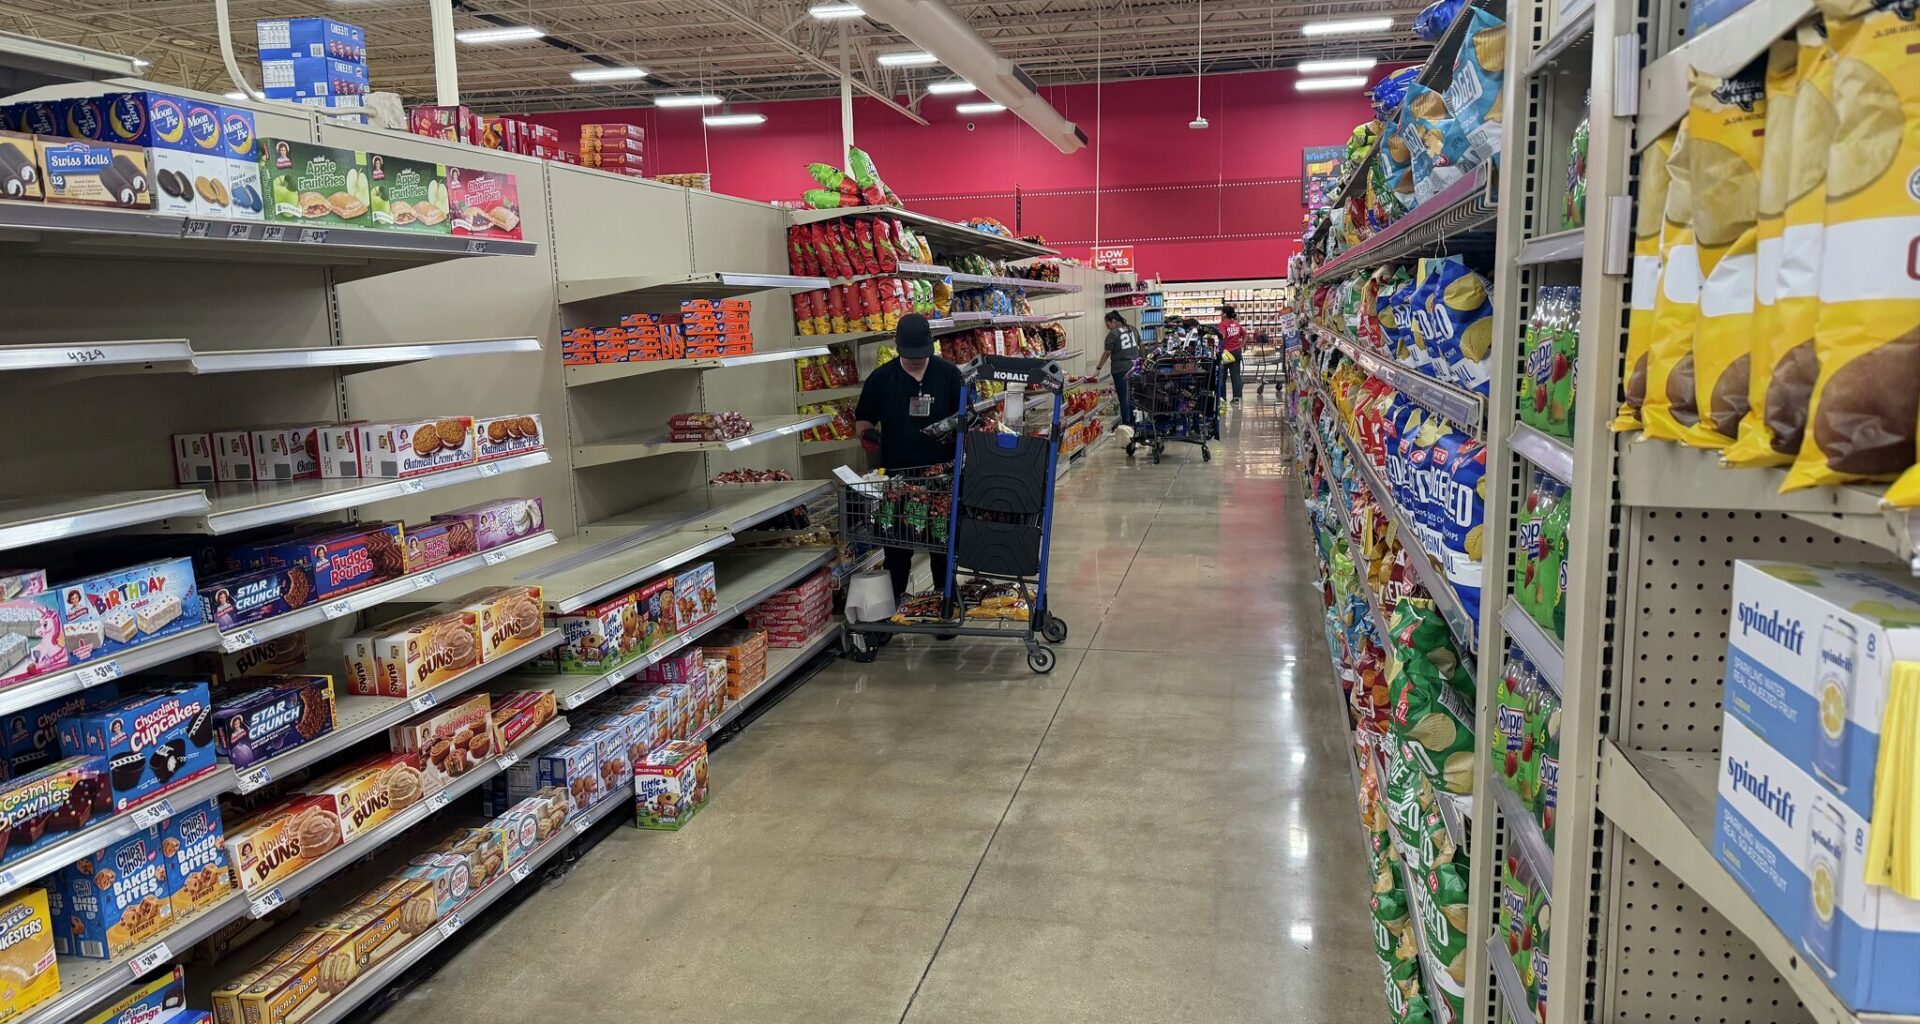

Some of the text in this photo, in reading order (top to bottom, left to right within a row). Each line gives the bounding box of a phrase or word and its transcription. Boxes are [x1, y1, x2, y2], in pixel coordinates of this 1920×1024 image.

[150, 107, 173, 121] Moon
[166, 115, 179, 128] Pie
[187, 114, 209, 128] Moon
[202, 121, 214, 134] Pie
[223, 121, 243, 134] Moon
[237, 129, 248, 141] Pie
[51, 155, 109, 167] Swiss Rolls
[306, 161, 336, 176] Apple
[52, 176, 64, 185] 12
[298, 175, 345, 190] Fruit Pies
[396, 172, 421, 189] Apple
[468, 179, 496, 193] Cherry
[389, 185, 428, 200] Fruit Pies
[465, 190, 501, 206] Fruit Pies
[1100, 250, 1123, 258] LOW
[1120, 332, 1137, 350] 21
[67, 349, 106, 363] 4329
[993, 371, 1030, 381] KOBALT
[481, 442, 507, 456] Oatmeal
[508, 440, 527, 450] Creme
[404, 449, 471, 470] Oatmeal Creme Pies
[332, 548, 368, 570] Fudge
[330, 560, 373, 586] Rounds
[235, 586, 281, 610] CRUNCH
[237, 579, 267, 598] STAR
[130, 599, 149, 610] Cakes
[491, 618, 521, 649] BUNS
[563, 619, 583, 636] Little
[570, 628, 592, 642] Bites
[609, 622, 623, 643] Bites
[1738, 601, 1805, 656] spindrift
[1867, 634, 1877, 652] 8
[418, 647, 454, 682] BUNS
[354, 662, 368, 693] BUNS
[387, 663, 399, 694] BUNS
[135, 699, 180, 730] Chocolate
[248, 705, 300, 740] CRUNCH
[251, 700, 286, 725] STAR
[130, 700, 202, 752] Cupcakes
[357, 781, 381, 807] Honey
[641, 778, 661, 792] Little
[647, 787, 668, 799] Bites
[1727, 755, 1796, 828] spindrift
[3, 780, 58, 811] Cosmic
[118, 797, 128, 810] 6
[352, 791, 389, 828] BUNS
[181, 815, 203, 837] Chips
[259, 828, 289, 856] Honey
[1854, 827, 1864, 846] 8
[116, 844, 140, 868] Chips
[177, 834, 215, 863] BAKED
[255, 837, 301, 880] BUNS
[180, 847, 217, 877] BITES
[113, 864, 156, 896] BAKED
[116, 879, 159, 910] BITES
[130, 919, 155, 937] BLONDIE
[357, 917, 399, 953] Honey Buns
[112, 990, 149, 1015] FAMILY PACK
[273, 975, 317, 1018] Honey Buns
